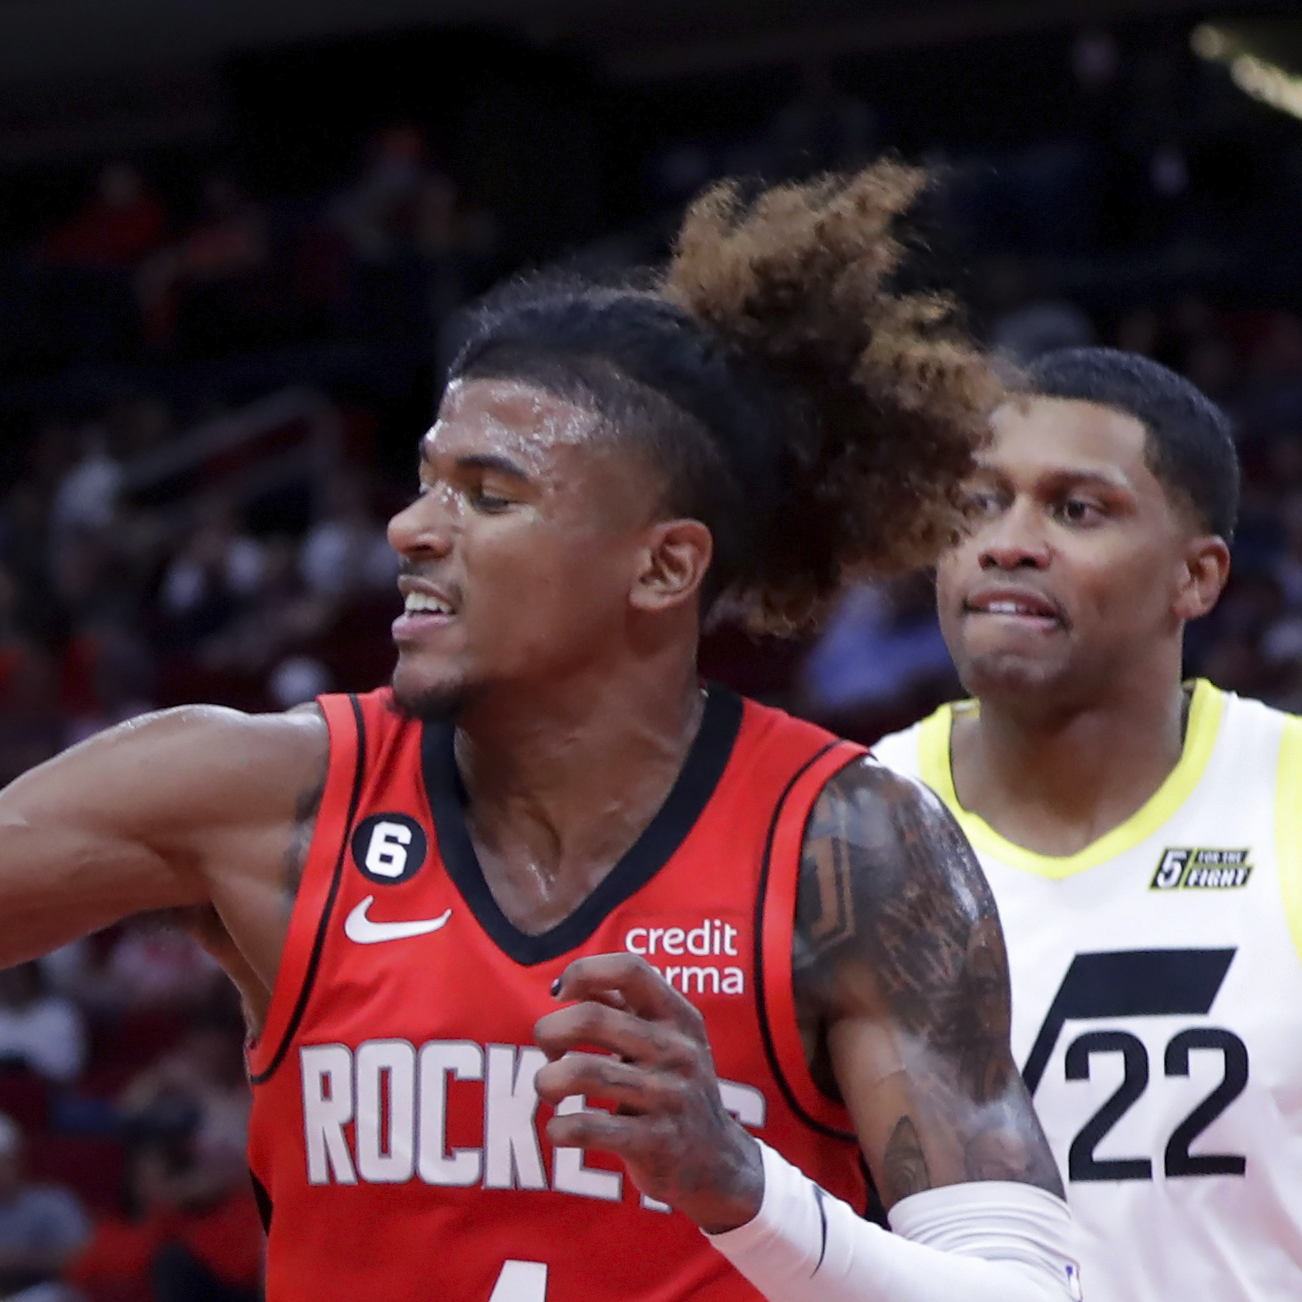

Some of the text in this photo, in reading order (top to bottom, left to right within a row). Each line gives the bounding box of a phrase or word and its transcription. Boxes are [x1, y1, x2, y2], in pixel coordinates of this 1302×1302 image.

[365, 820, 412, 878] 6
[1156, 849, 1187, 888] 5
[625, 918, 739, 957] credit
[650, 965, 745, 995] rma
[1064, 1026, 1249, 1183] 22
